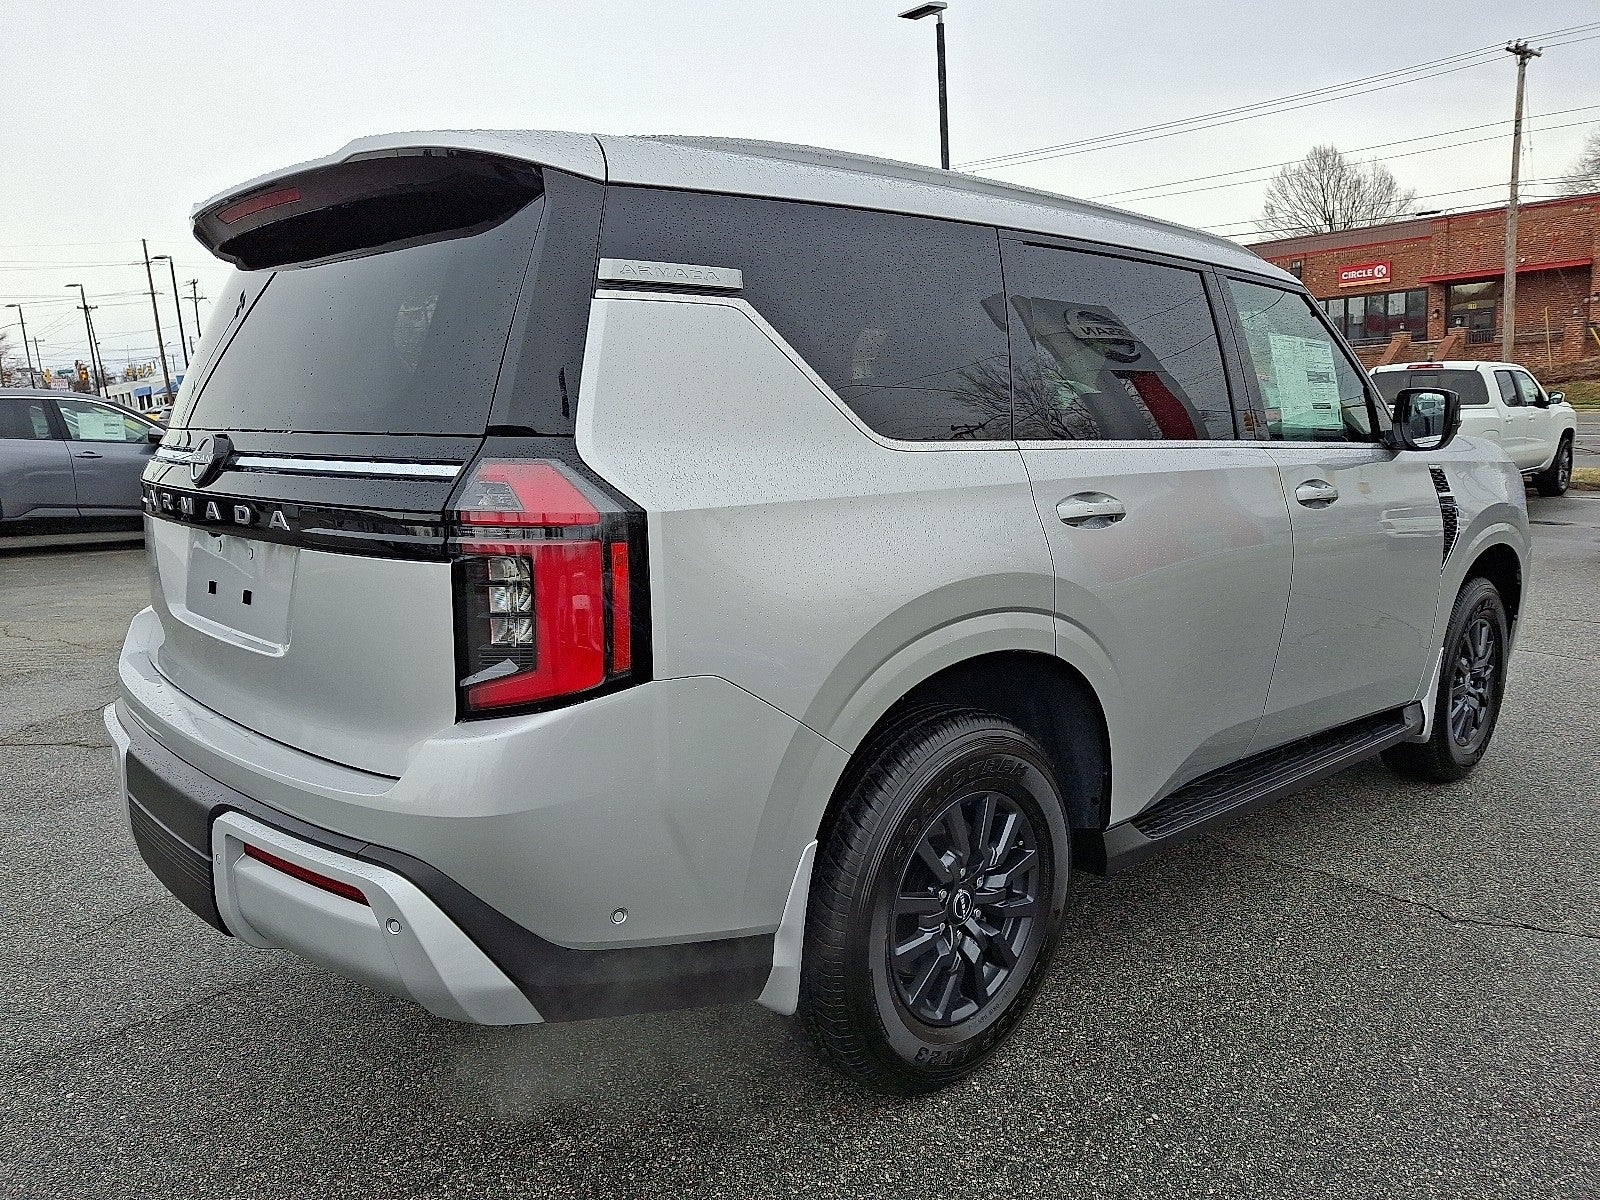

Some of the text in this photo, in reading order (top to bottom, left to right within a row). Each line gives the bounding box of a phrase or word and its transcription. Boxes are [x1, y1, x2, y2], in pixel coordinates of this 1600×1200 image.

[620, 264, 720, 281] ARMADA
[1341, 268, 1373, 280] CIRCLE
[140, 489, 290, 531] ARMADA
